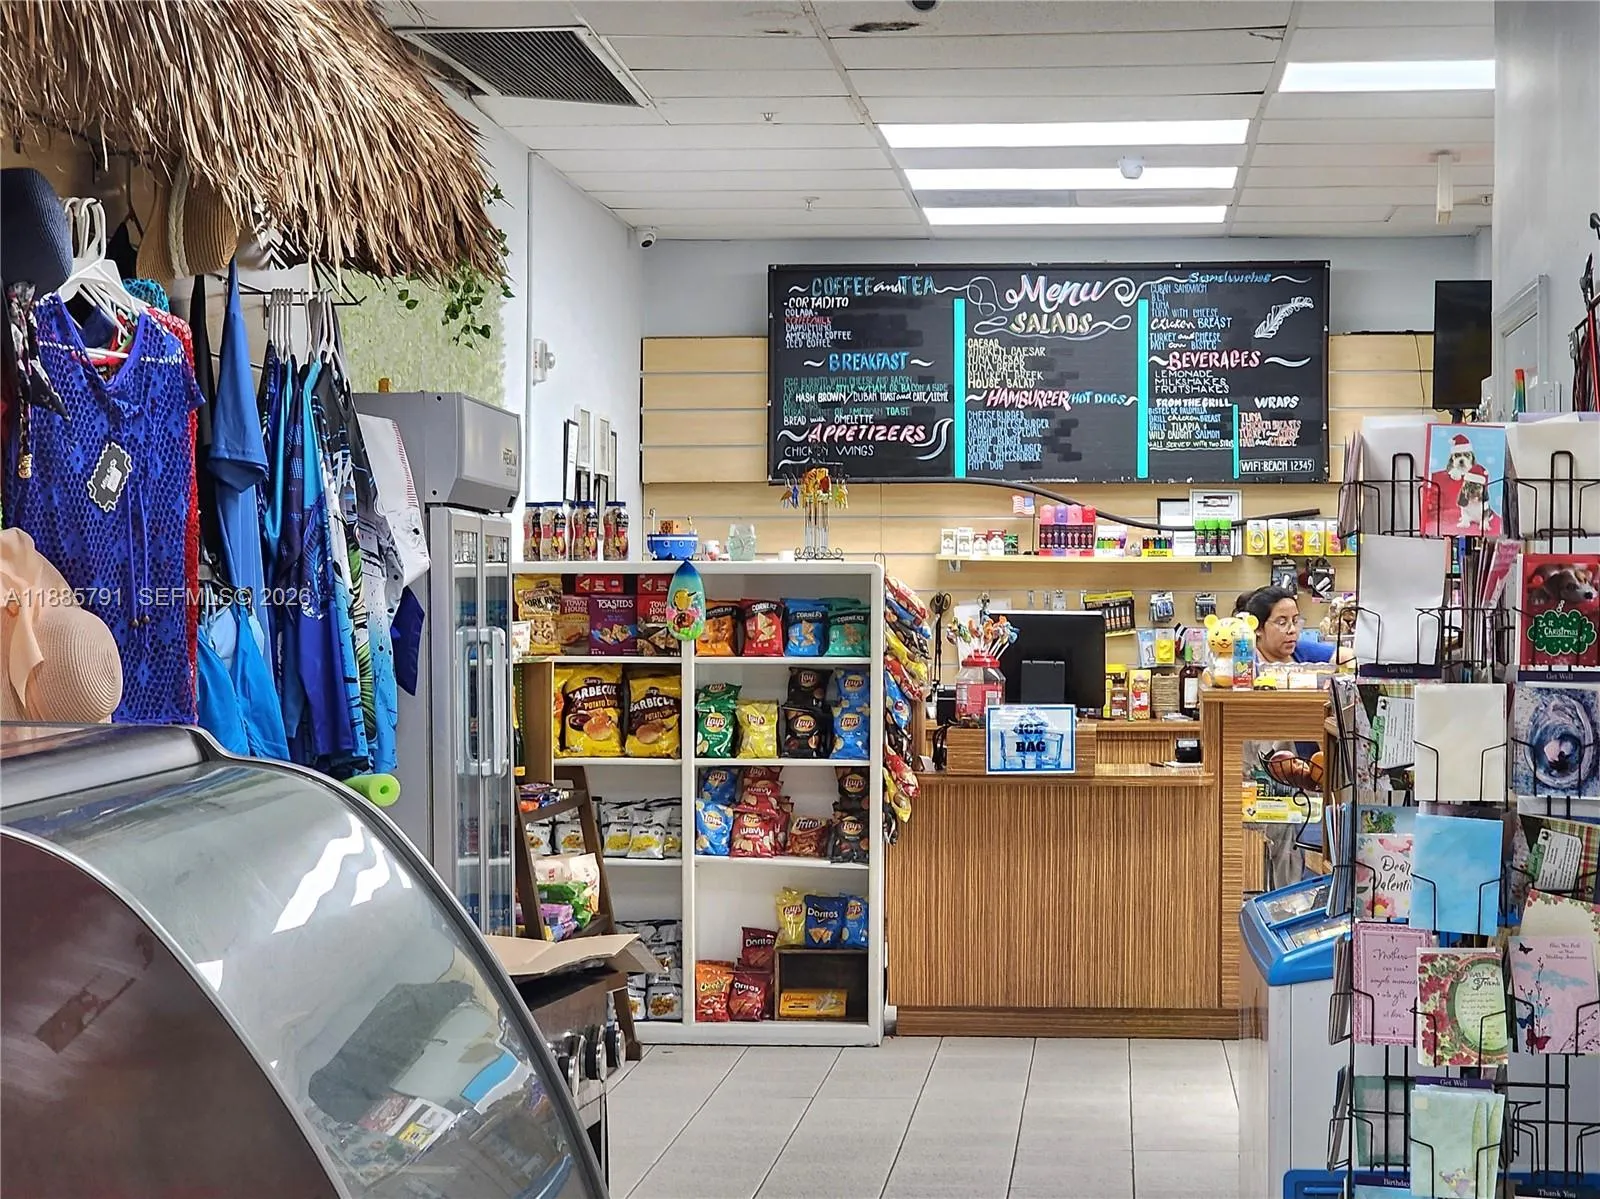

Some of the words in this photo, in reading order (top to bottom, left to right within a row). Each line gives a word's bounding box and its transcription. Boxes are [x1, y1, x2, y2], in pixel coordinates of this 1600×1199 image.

[811, 276, 875, 296] COFFEE
[873, 280, 901, 293] and
[900, 275, 937, 296] TEA
[1173, 283, 1208, 293] SANDWICH
[1006, 274, 1105, 313] Menu
[1172, 308, 1188, 318] WITH
[1192, 308, 1219, 318] CHEESE
[1010, 312, 1093, 335] SALADS
[1197, 317, 1233, 330] BREAST
[785, 331, 823, 341] AMERICAN
[824, 331, 852, 341] COFFEE
[1150, 332, 1177, 342] TURKEY
[1194, 332, 1222, 342] CHEESE
[786, 339, 803, 349] ICED
[806, 339, 832, 348] COFFEE
[968, 338, 1000, 349] CAESAR
[1191, 341, 1217, 350] BISTEC
[1010, 346, 1046, 357] CAESAR
[828, 353, 910, 371] BREAKFAST
[968, 355, 992, 365] TUNA
[992, 355, 1025, 365] CAESAR
[1166, 349, 1262, 371] BEVERAGES
[968, 363, 993, 374] TUNA
[996, 363, 1026, 373] GREEK
[1155, 370, 1213, 378] LEMONADE
[968, 371, 1008, 381] CHICKEN
[1014, 370, 1044, 381] GREEK
[968, 380, 1000, 389] HOUSE
[1007, 379, 1035, 389] SALAD
[1155, 377, 1227, 386] MILKSHAKES
[889, 384, 899, 392] OR
[901, 384, 924, 393] BACON
[932, 384, 948, 392] SIDE
[1155, 385, 1230, 394] FRUITSHAKES
[795, 393, 815, 402] HASH
[879, 392, 896, 402] TOAST
[896, 392, 912, 400] and
[1095, 392, 1128, 405] DOGS
[1156, 398, 1182, 408] FROM
[1182, 398, 1202, 407] THE
[1202, 397, 1233, 408] GRILL
[1254, 395, 1300, 409] WRAPS
[886, 407, 910, 416] TOAST
[968, 410, 1025, 421] CHEESEBURGER
[784, 415, 807, 426] BREAD
[834, 414, 875, 424] OMELETTE
[1200, 414, 1221, 423] BREAST
[968, 420, 993, 429] BACON
[1149, 423, 1167, 431] GRILL
[1171, 422, 1201, 432] TILAPIA
[807, 423, 927, 444] APPETIZERS
[1149, 431, 1166, 440] WILD
[1168, 430, 1193, 440] CAUGHT
[1194, 429, 1220, 439] SALMON
[784, 446, 829, 457] CHICKN
[835, 444, 875, 457] WINGS
[968, 461, 983, 470] HOT
[989, 461, 1004, 470] DOG
[1290, 459, 1312, 471] 12345
[1308, 532, 1321, 552] 4
[564, 606, 588, 614] HOUSE
[597, 599, 634, 610] TOASTEDS
[1018, 723, 1044, 735] ICE
[1016, 741, 1047, 753] BAG
[1381, 855, 1412, 872] Dear
[807, 907, 840, 919] Doritos
[1454, 1079, 1468, 1087] Well
[1383, 1178, 1410, 1188] Birthday
[1537, 1188, 1561, 1197] Thank
[1562, 1189, 1577, 1198] You
